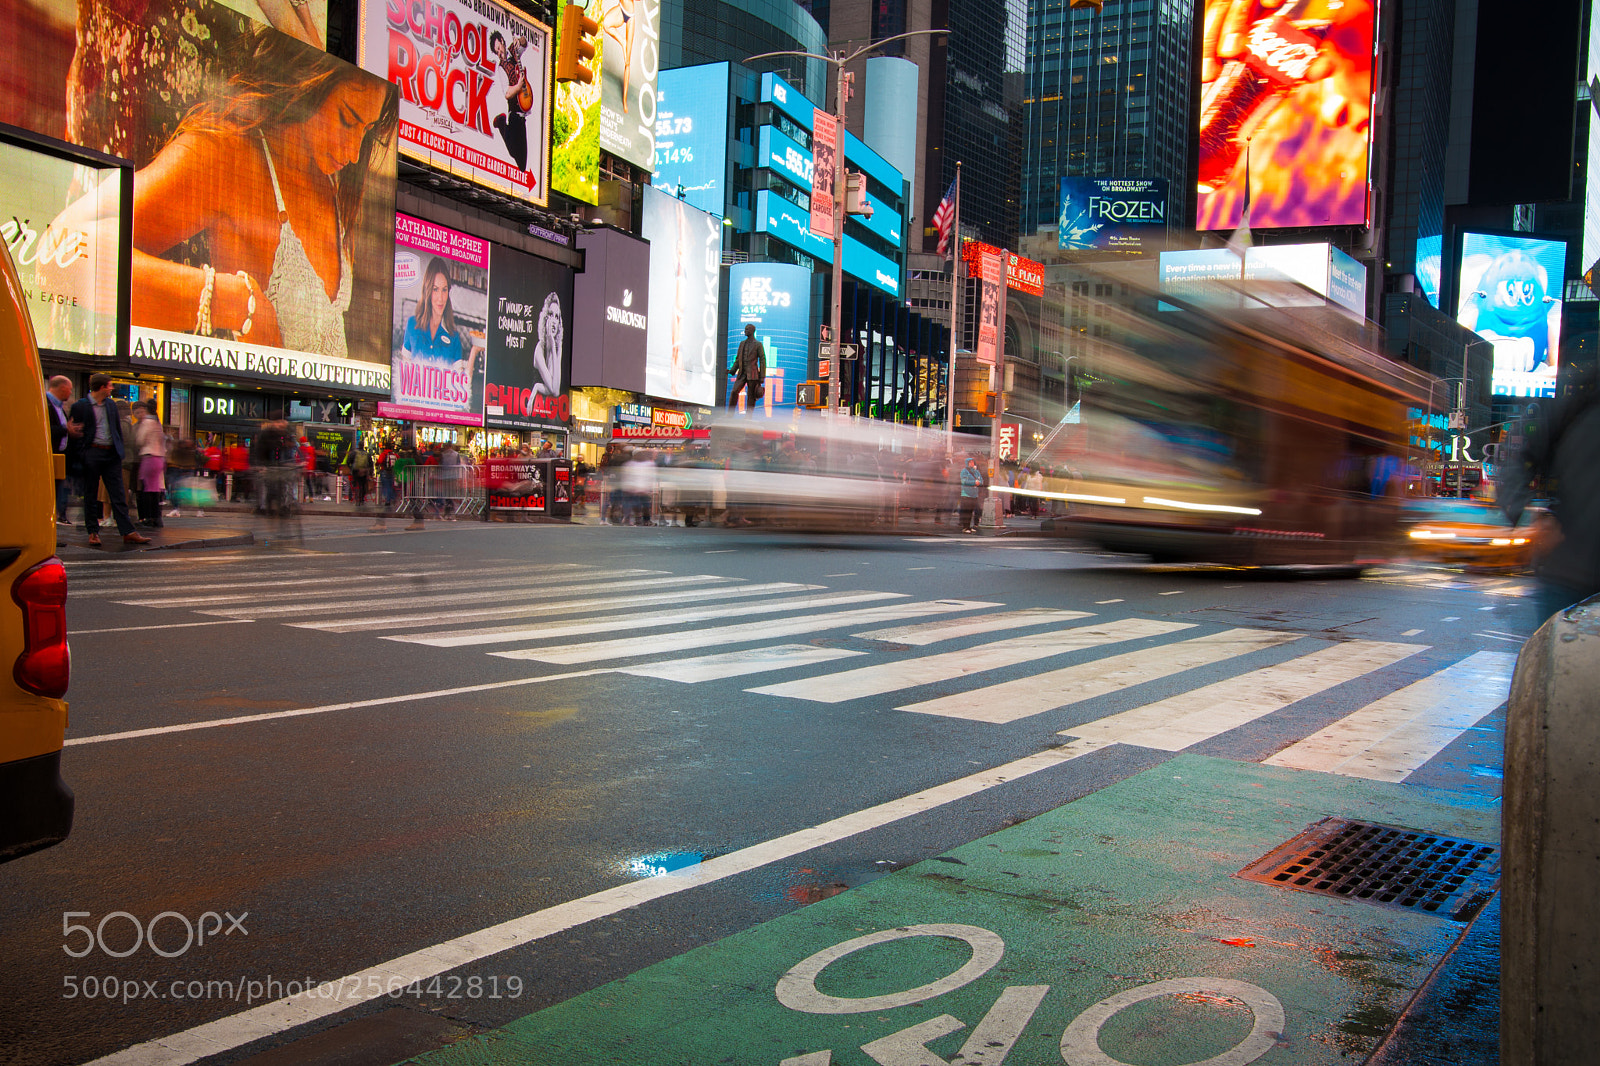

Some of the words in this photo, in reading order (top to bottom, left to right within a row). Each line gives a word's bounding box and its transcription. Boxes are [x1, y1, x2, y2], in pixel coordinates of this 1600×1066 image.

[473, 0, 510, 30] BROADWAY
[387, 0, 497, 74] SCHOOL
[434, 44, 457, 77] of
[387, 28, 495, 138] ROCK
[638, 0, 659, 167] JOCK
[400, 123, 415, 140] JUST
[417, 131, 422, 143] 4
[422, 132, 446, 152] BLOCKS
[446, 141, 454, 156] TO
[455, 144, 465, 159] THE
[466, 147, 487, 168] WINTER
[487, 156, 507, 175] GARDEN
[507, 164, 528, 185] THEATRE
[1089, 196, 1164, 222] FROZEN
[395, 216, 448, 244] KATHARINE
[450, 233, 483, 254] McPHEE
[395, 231, 409, 243] NOW
[411, 236, 440, 252] STARRING
[441, 245, 450, 255] ON
[451, 248, 482, 264] BROADWAY
[1019, 269, 1041, 285] PLAZA
[1165, 264, 1187, 273] Every
[1188, 263, 1206, 272] time
[1213, 263, 1230, 271] new
[1231, 260, 1265, 272] Hyndai
[1235, 271, 1255, 281] fiht
[741, 277, 772, 293] AEX
[40, 291, 78, 307] EAGLE
[498, 297, 507, 313] IT
[506, 302, 522, 317] WOULD
[523, 304, 534, 318] BE
[498, 316, 526, 333] CRIMINAL
[525, 319, 533, 334] TO
[607, 306, 647, 330] SWAROVSKI
[505, 333, 519, 349] MISS
[519, 336, 527, 349] IT
[131, 336, 240, 371] AMERICAN
[245, 351, 298, 377] EAGLE
[302, 361, 391, 390] OUTFITTERS
[400, 361, 469, 404] WAITRESS
[203, 397, 258, 418] DRINK
[485, 382, 570, 422] CHICAGO
[640, 406, 652, 417] FIN
[654, 411, 664, 424] DOS
[664, 412, 685, 426] CAMINOS
[422, 427, 458, 444] GRAND
[621, 423, 683, 438] nuchas
[1000, 426, 1015, 461] tkts
[1449, 434, 1480, 462] R
[491, 464, 536, 472] BROADWAY'S
[490, 495, 545, 508] CHICAGO
